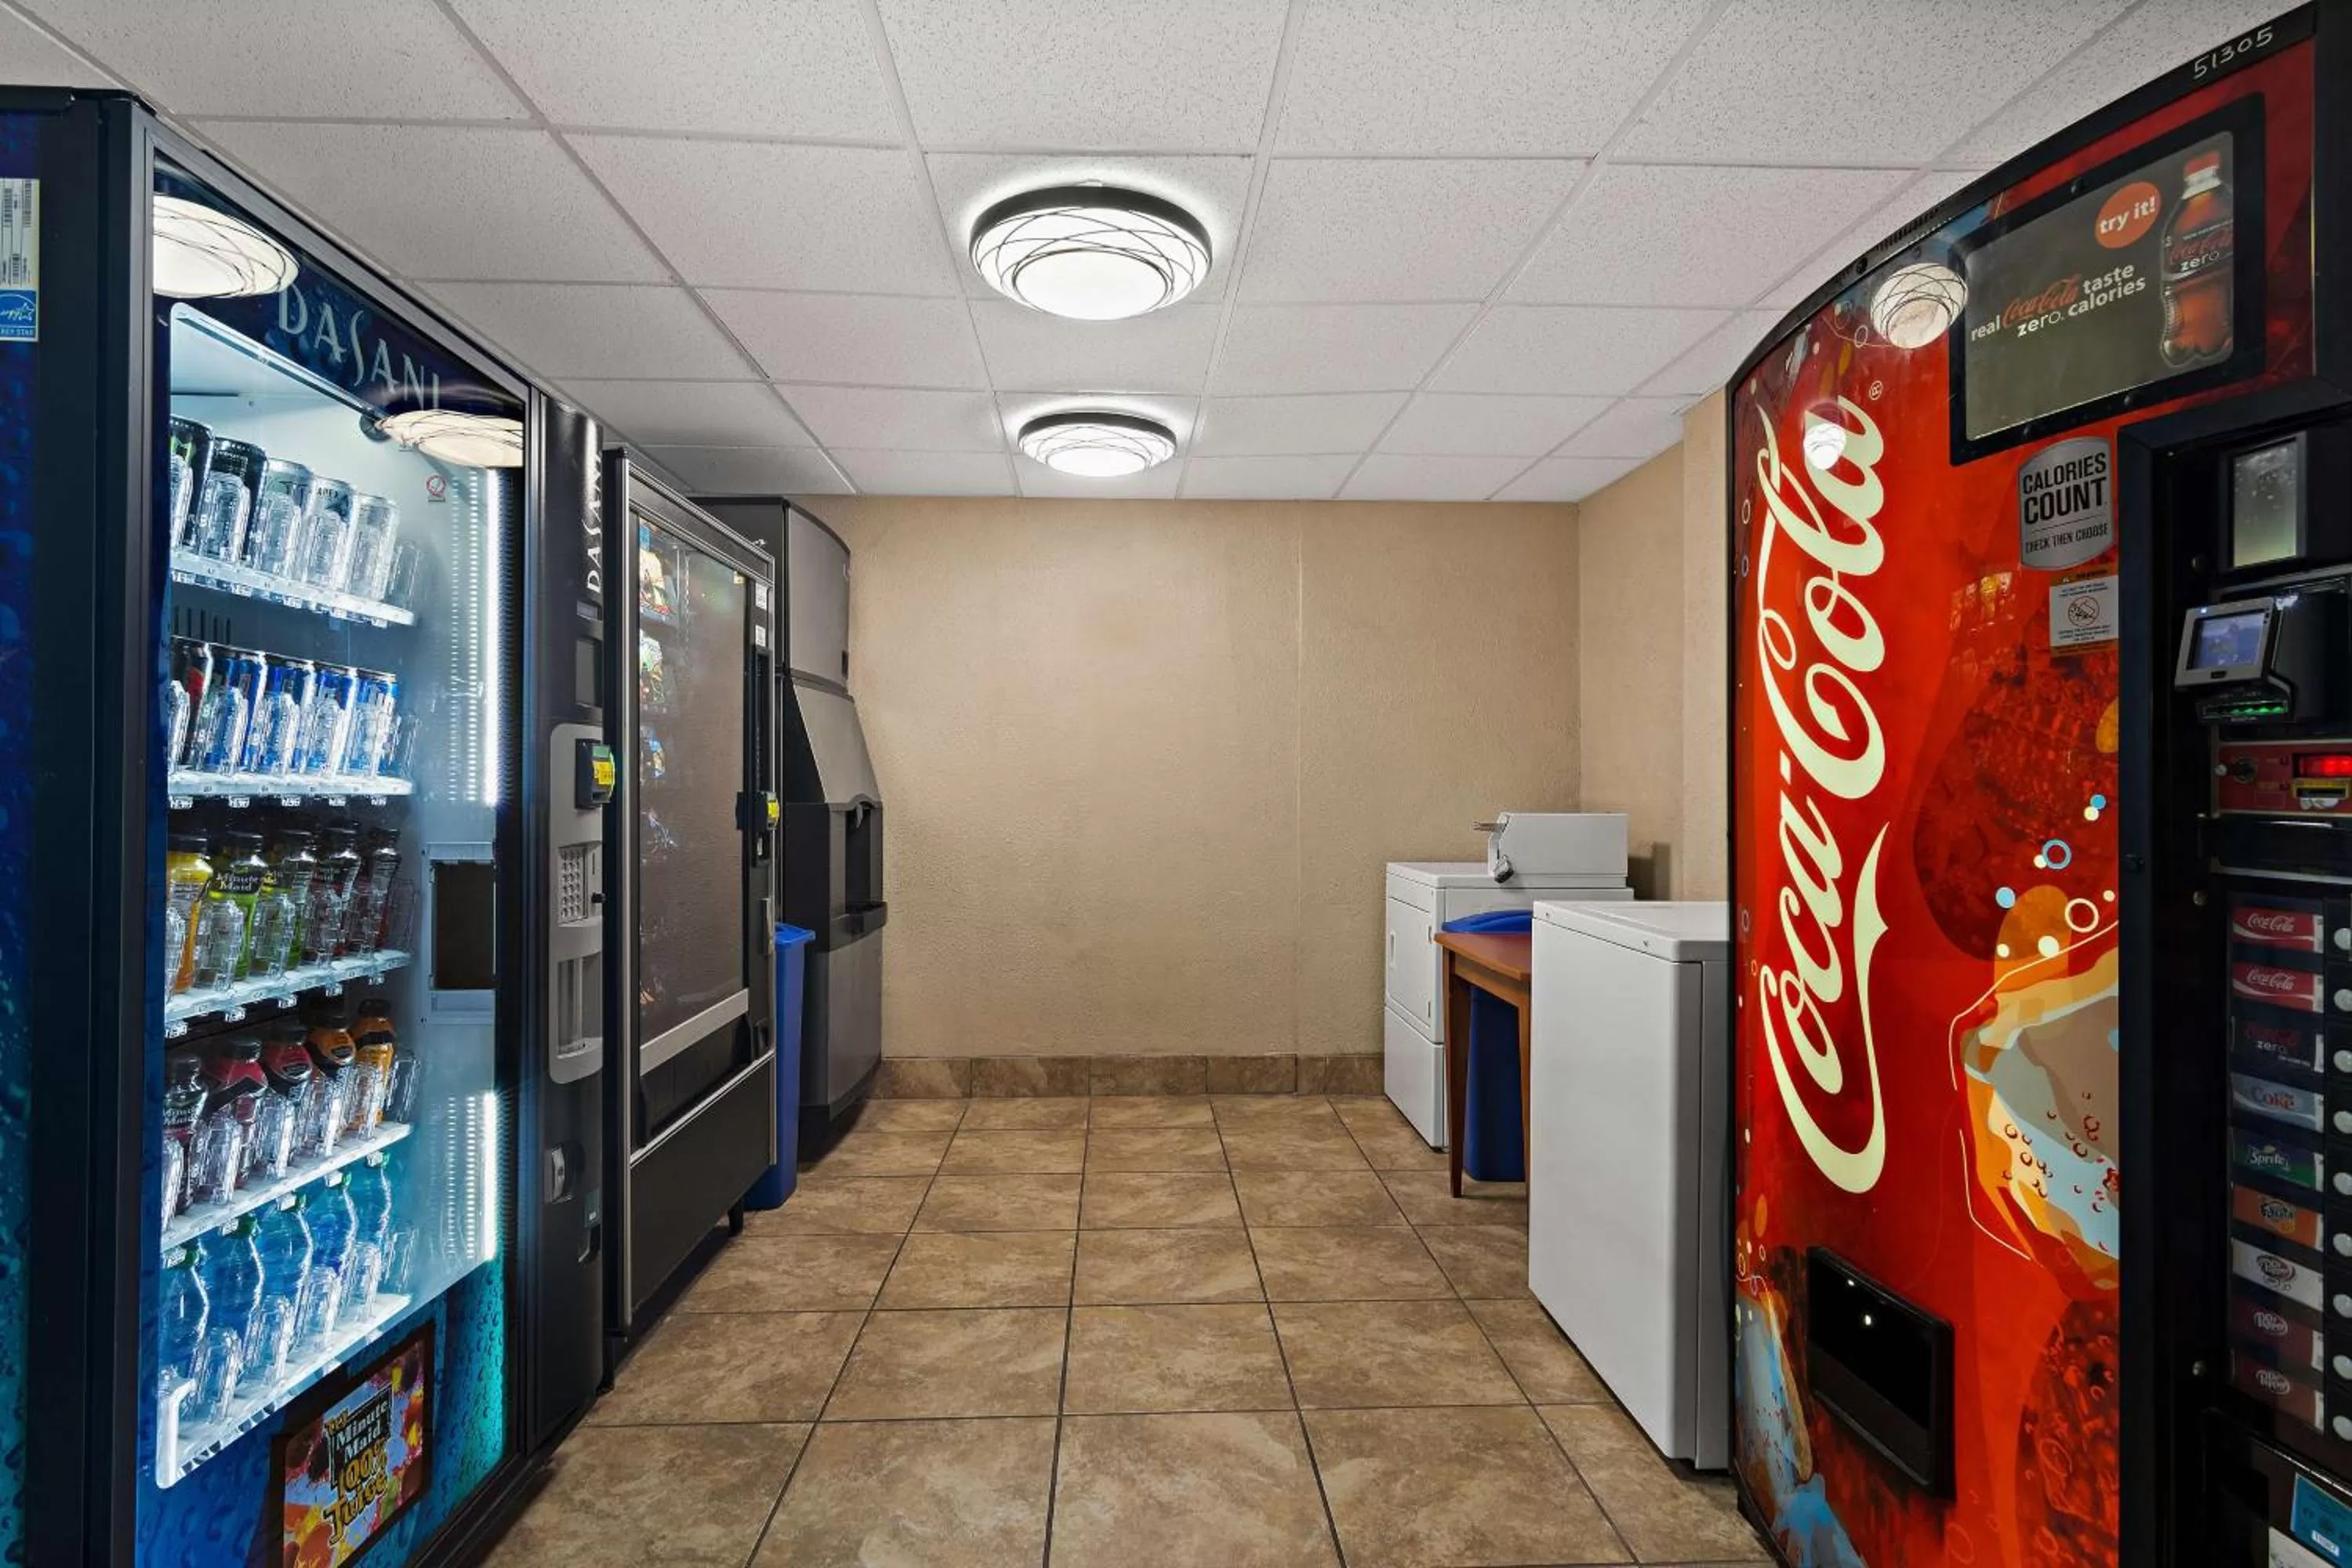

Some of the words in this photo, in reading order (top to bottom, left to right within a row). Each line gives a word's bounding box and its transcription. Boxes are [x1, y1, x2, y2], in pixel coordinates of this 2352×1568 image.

[2194, 26, 2273, 79] 51305
[2099, 211, 2129, 234] try
[2133, 196, 2156, 220] it!
[2180, 250, 2220, 272] zero
[1970, 314, 2000, 342] real
[2002, 274, 2082, 328] Coca-Cola
[2082, 264, 2135, 295] taste
[2067, 277, 2146, 317] calories
[278, 284, 440, 411] DASANI
[2022, 452, 2107, 495] CALORIES
[2024, 476, 2107, 525] COUNT
[2025, 536, 2050, 554] CHECK
[2052, 531, 2073, 548] THEN
[2075, 523, 2109, 542] CHOOSE
[1758, 394, 1890, 1194] Coca-Cola
[2249, 1149, 2285, 1167] Sprite
[336, 1399, 389, 1450] Minute
[343, 1420, 382, 1465] Maid
[337, 1438, 388, 1499] 100%
[322, 1471, 388, 1546] Juice
